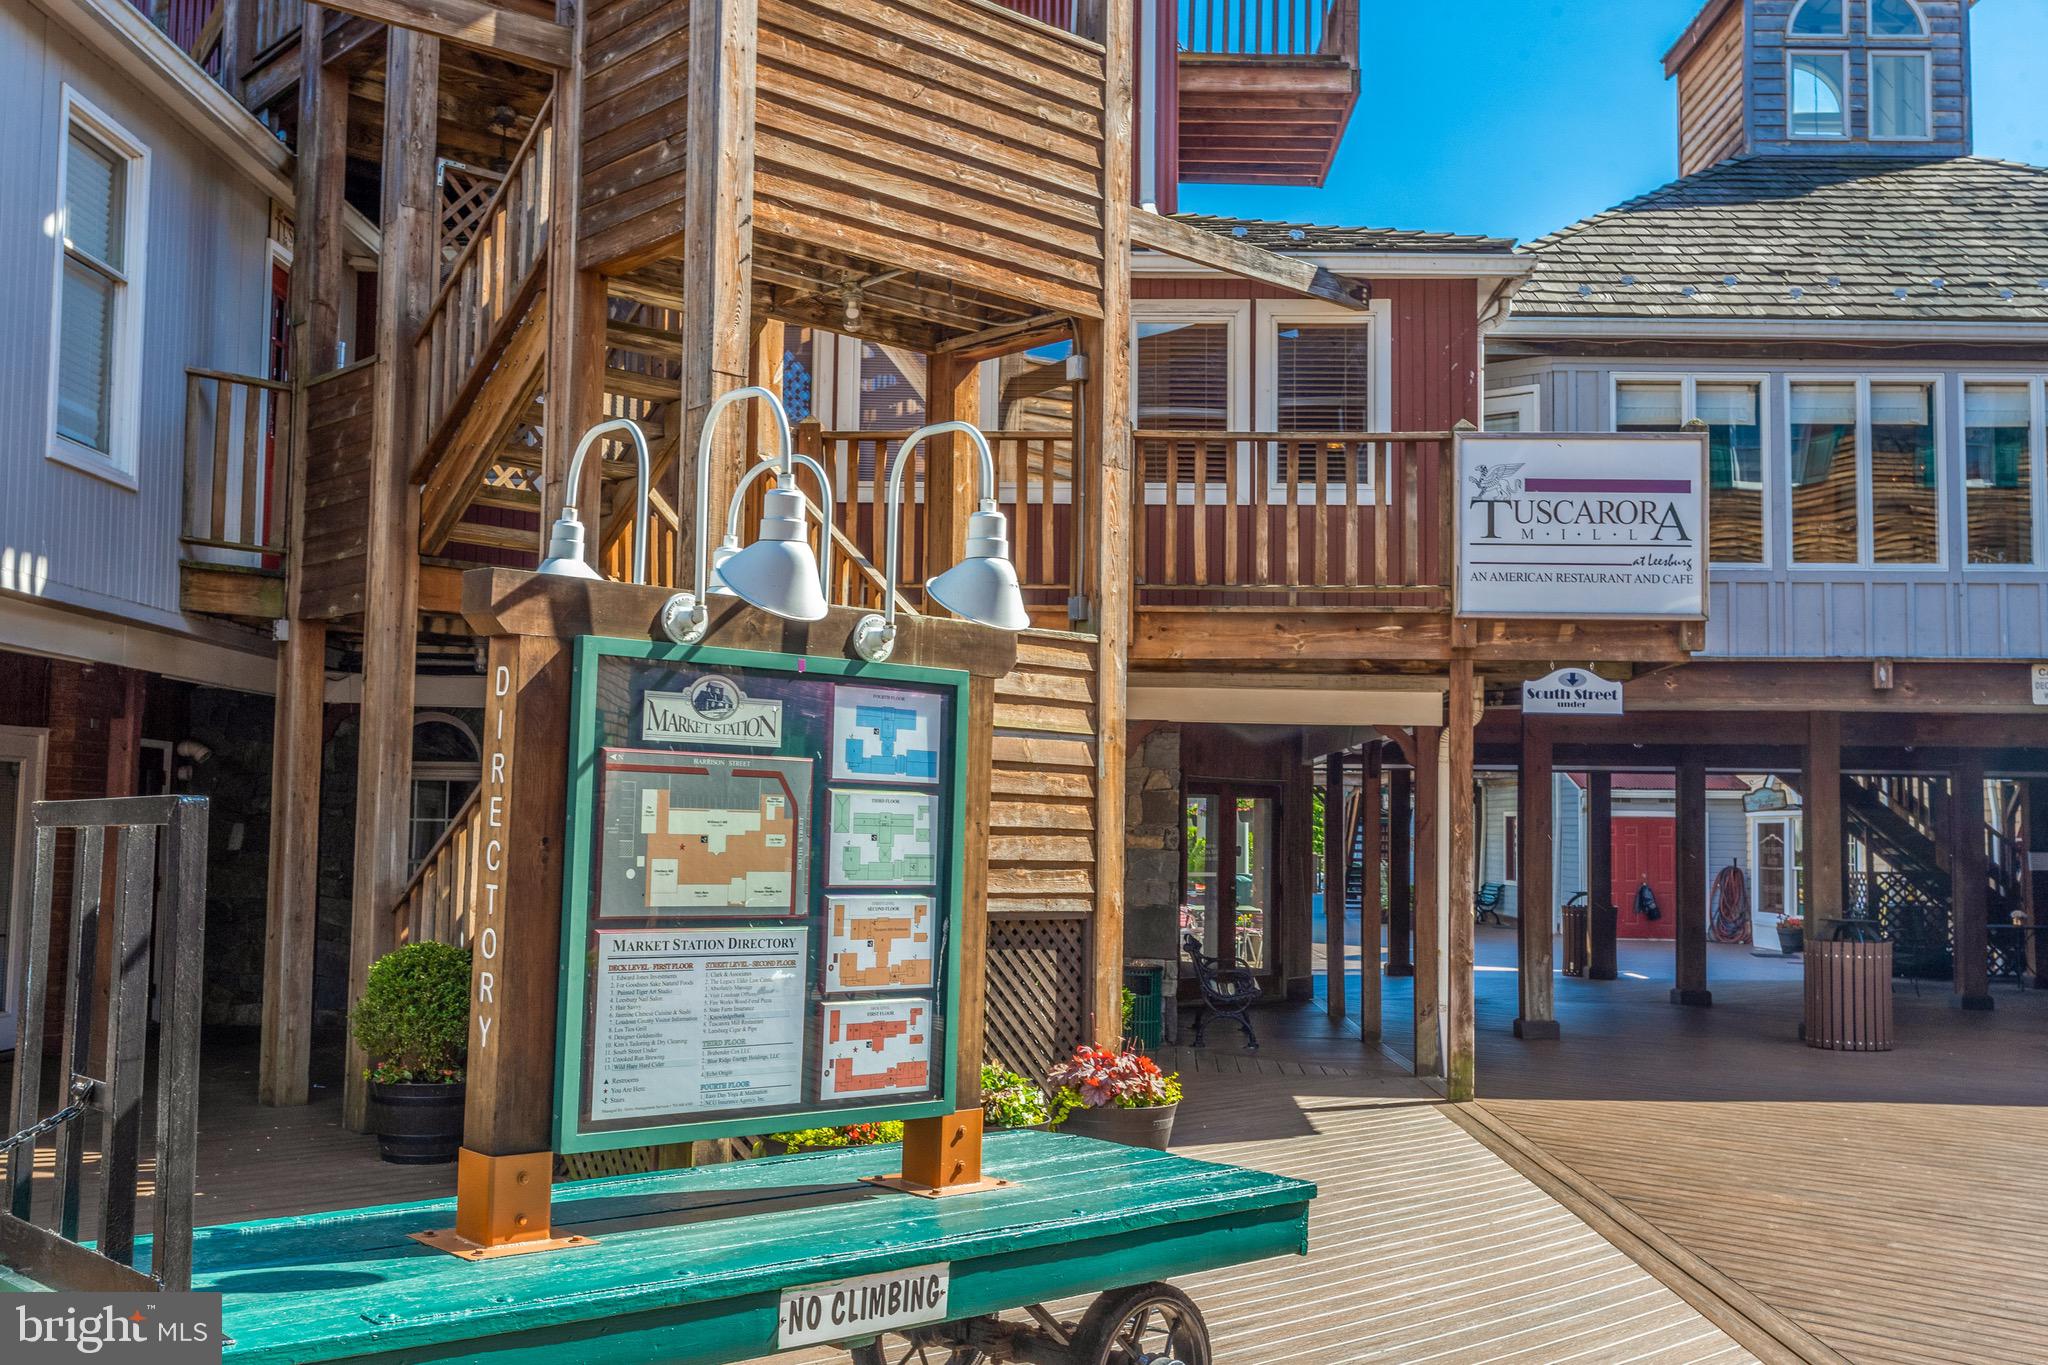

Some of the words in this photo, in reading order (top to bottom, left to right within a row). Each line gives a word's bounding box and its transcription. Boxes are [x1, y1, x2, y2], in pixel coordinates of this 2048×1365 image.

[1470, 500, 1692, 541] TUSCARORA
[1632, 556, 1644, 567] at
[1648, 554, 1692, 571] Leesburg
[1470, 572, 1487, 582] AN
[1489, 572, 1553, 582] AMERICAN
[1556, 573, 1632, 584] RESTAURANT
[1634, 574, 1660, 584] AND
[1663, 575, 1693, 584] CAFE
[1527, 688, 1570, 700] South
[1574, 689, 1618, 700] Street
[646, 698, 712, 734] MARKET
[714, 708, 779, 738] STATION
[478, 665, 510, 1048] DIRECTORY
[612, 939, 670, 952] MARKET
[672, 938, 725, 950] STATION
[728, 937, 796, 950] DIRECTORY
[788, 1295, 822, 1335] NO
[831, 1274, 940, 1326] CLIMBING
